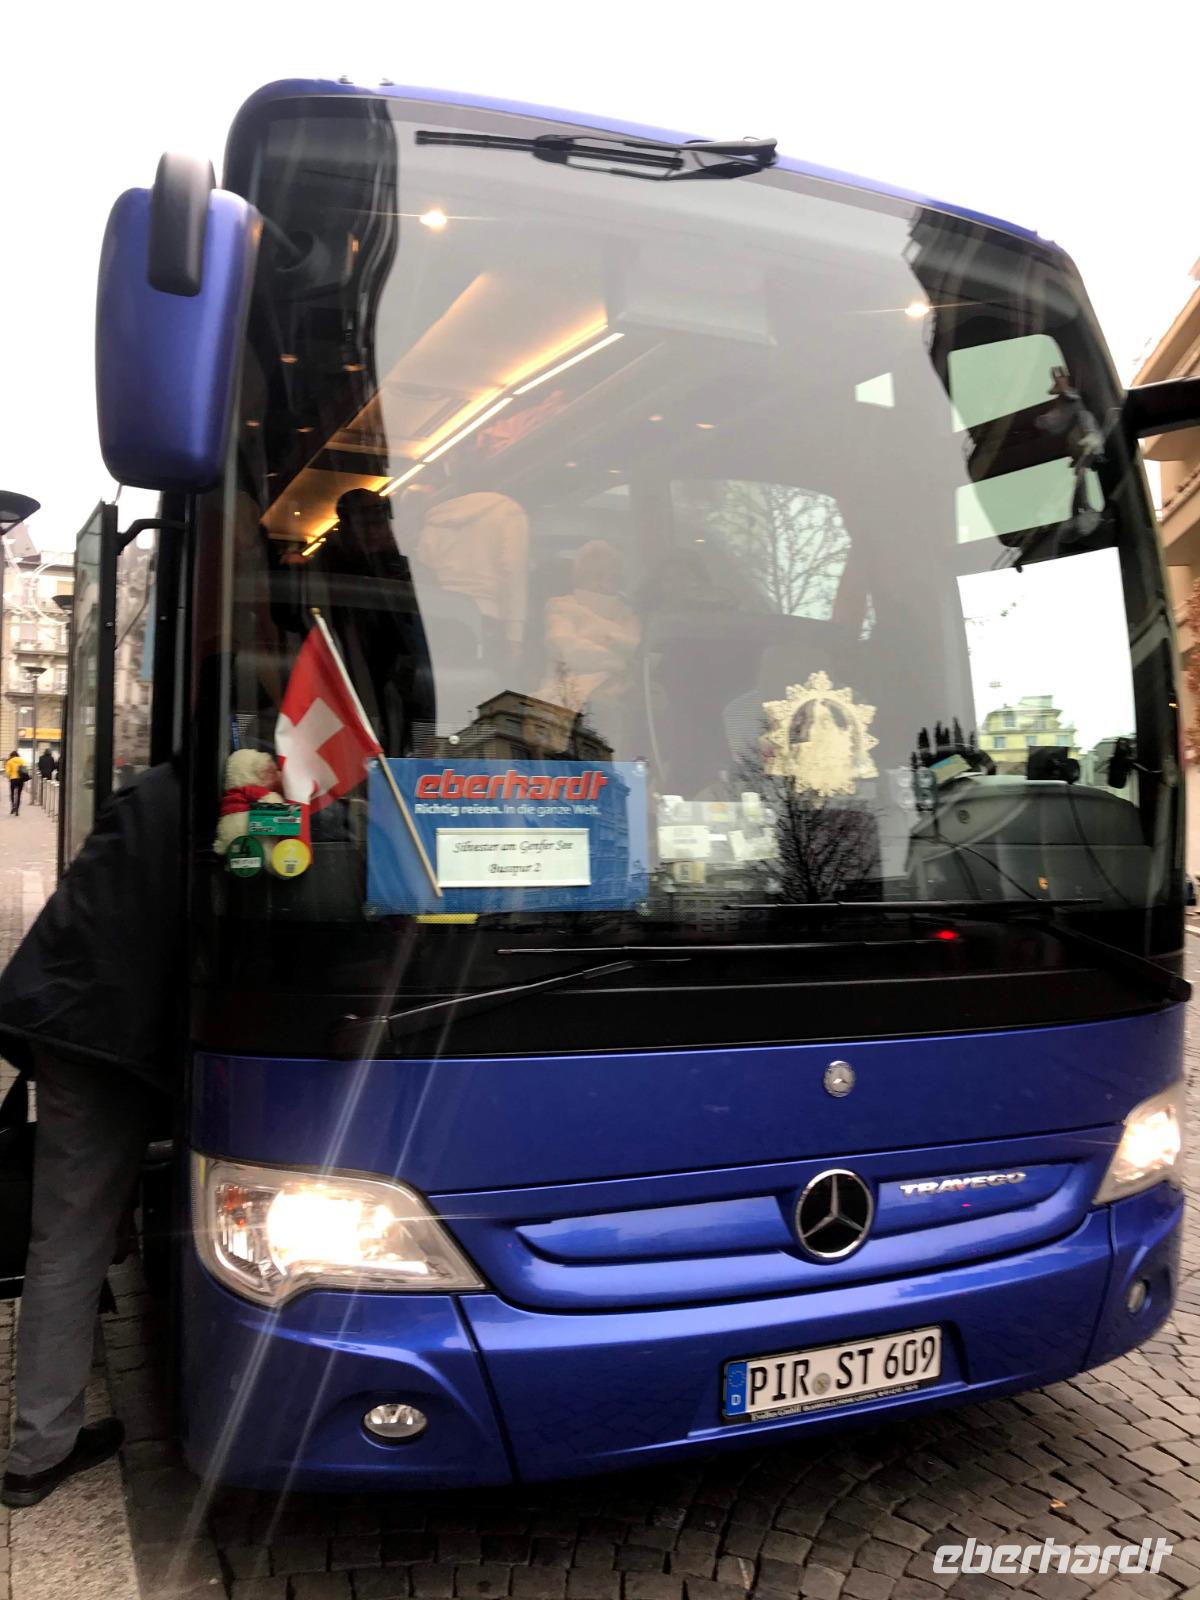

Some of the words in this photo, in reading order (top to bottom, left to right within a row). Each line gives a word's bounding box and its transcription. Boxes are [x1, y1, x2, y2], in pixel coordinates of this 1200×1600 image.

[415, 769, 609, 800] eberhardt
[414, 804, 461, 817] Richtig
[517, 804, 536, 815] die
[536, 806, 571, 817] ganze
[573, 804, 602, 816] Welt.
[900, 1172, 1026, 1197] TRAVEGO
[750, 1359, 810, 1405] PIR
[836, 1347, 874, 1390] ST
[884, 1335, 936, 1380] 609
[731, 1394, 742, 1406] D
